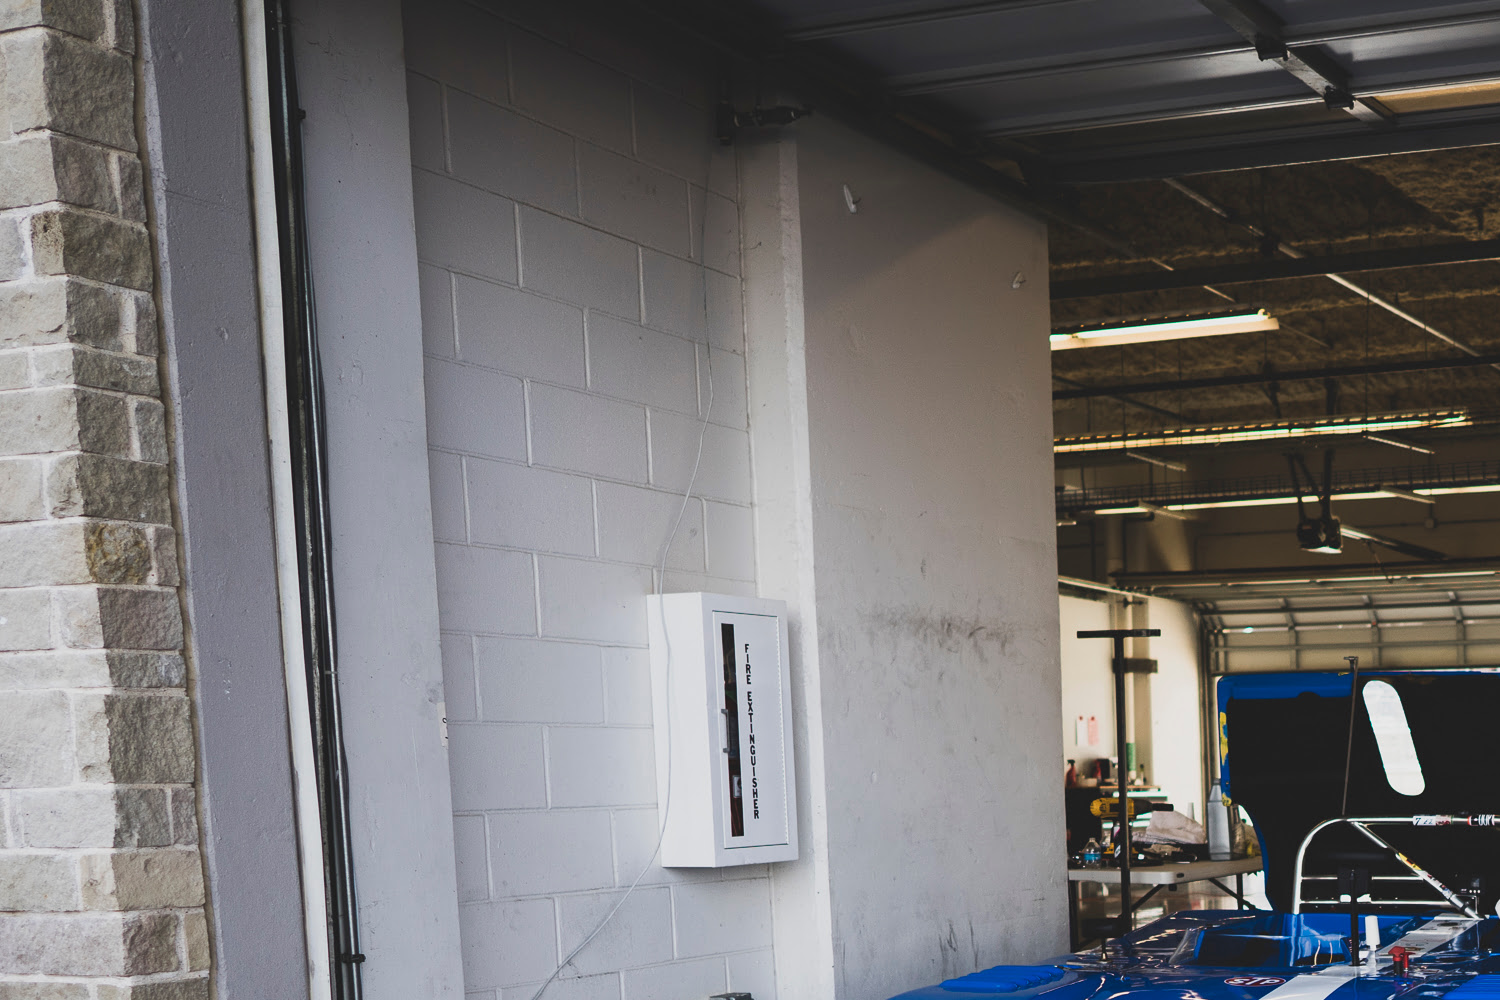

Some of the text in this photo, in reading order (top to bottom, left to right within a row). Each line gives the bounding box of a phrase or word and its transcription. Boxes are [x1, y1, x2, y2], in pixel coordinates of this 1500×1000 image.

[744, 643, 760, 820] FIRE EXTINGUISHER
[1228, 976, 1280, 986] STP
